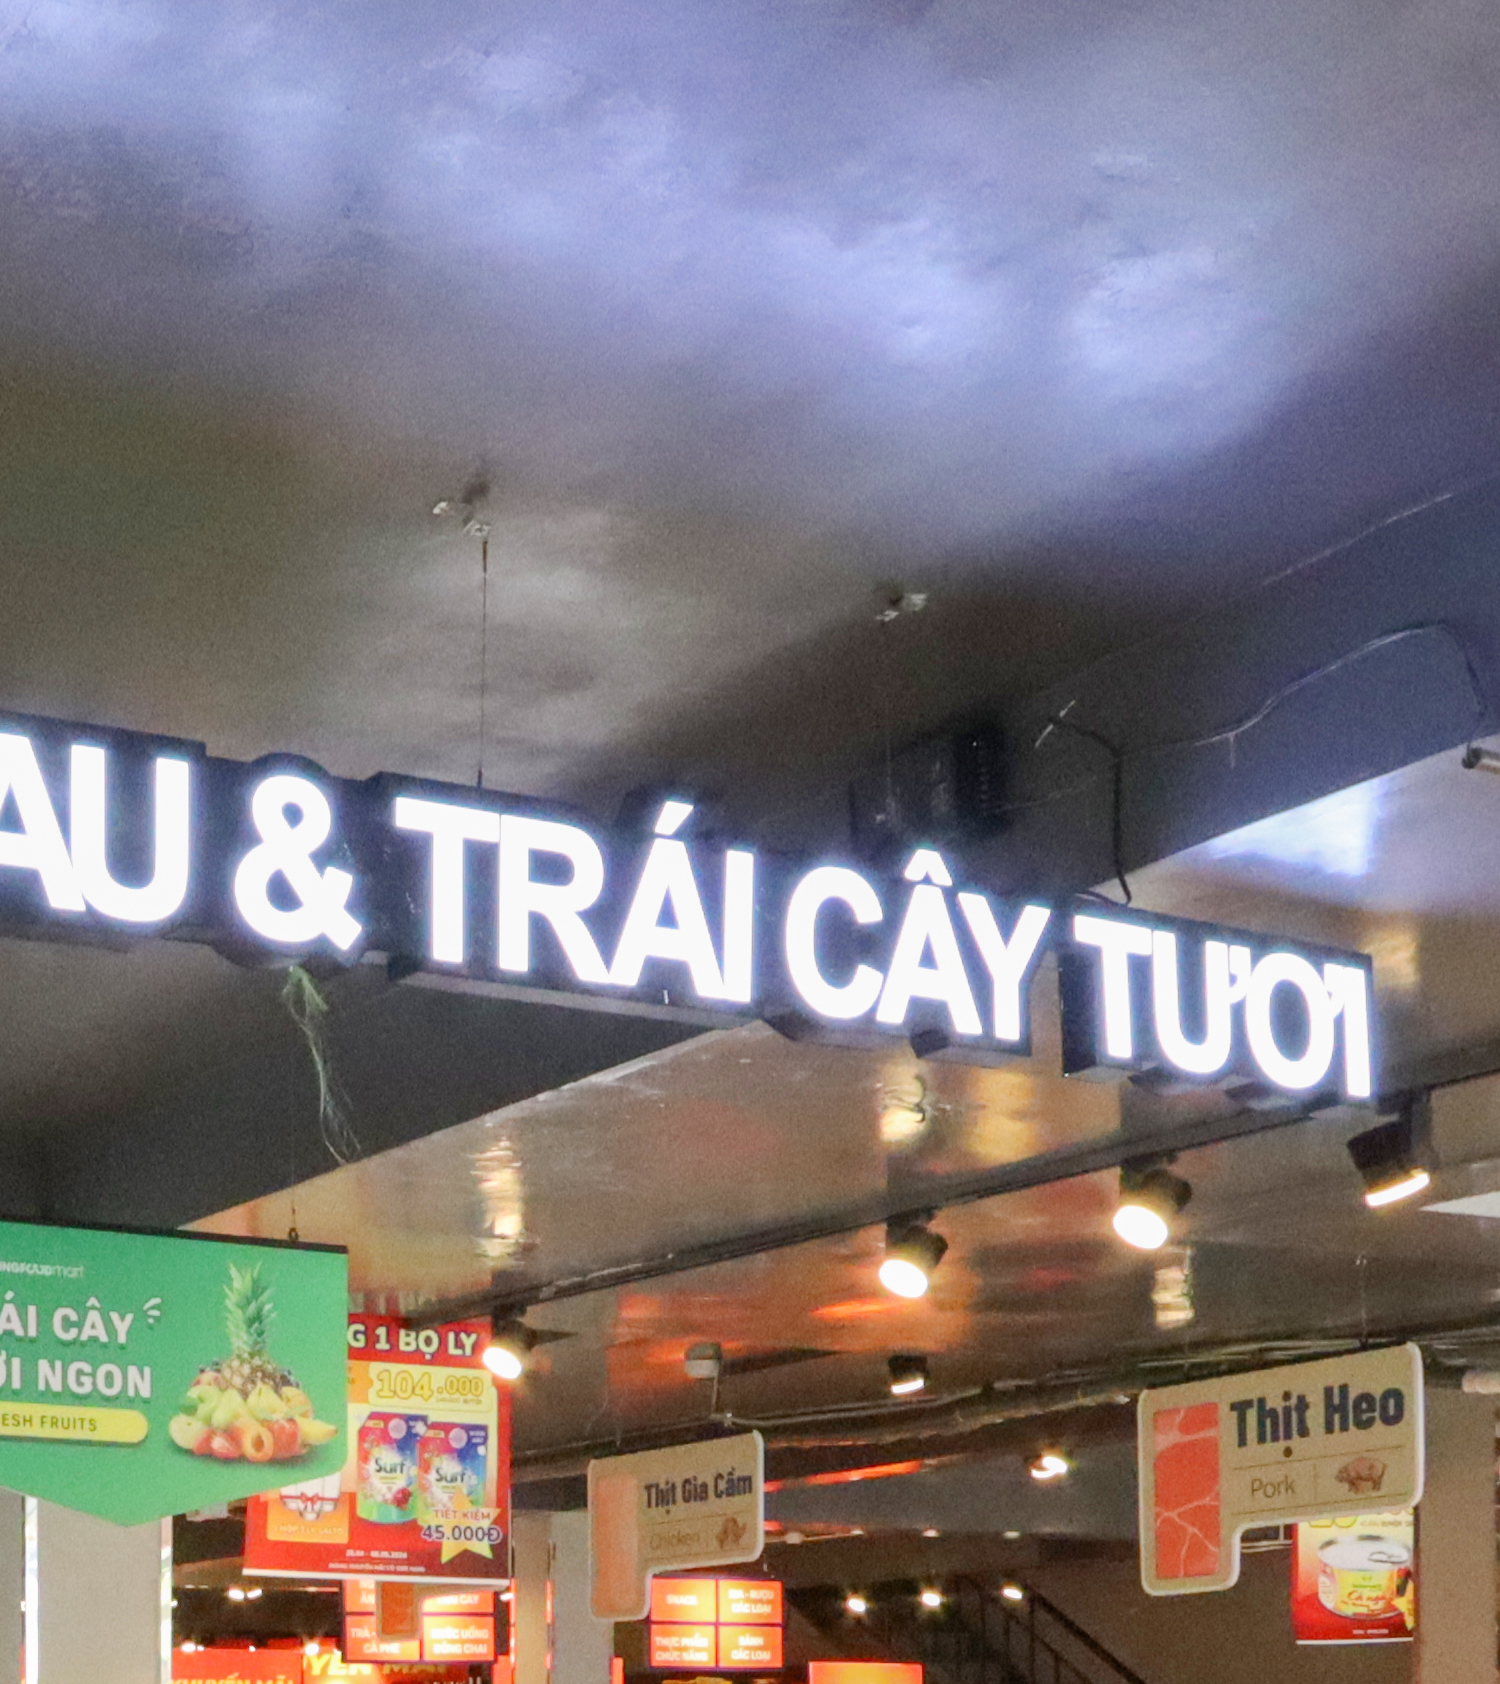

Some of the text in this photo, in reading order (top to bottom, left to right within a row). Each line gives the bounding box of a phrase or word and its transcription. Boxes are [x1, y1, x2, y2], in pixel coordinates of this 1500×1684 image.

[237, 773, 362, 952] &
[395, 802, 754, 1004] TRÁI
[784, 848, 1050, 1039] CÂY
[1076, 916, 1371, 1097] TƯƠI
[52, 1298, 134, 1345] CÂY
[375, 1327, 390, 1350] 1
[448, 1331, 477, 1356] LY
[37, 1358, 152, 1399] NGON
[377, 1369, 484, 1400] 104.000
[40, 1414, 98, 1433] FRUITS
[1230, 1383, 1405, 1458] Thịt Heo
[375, 1457, 407, 1474] Surf
[435, 1468, 466, 1483] Surf
[644, 1466, 753, 1515] Thịt Gia Cầm
[1251, 1476, 1296, 1498] Pork
[421, 1525, 502, 1543] 45.000Đ
